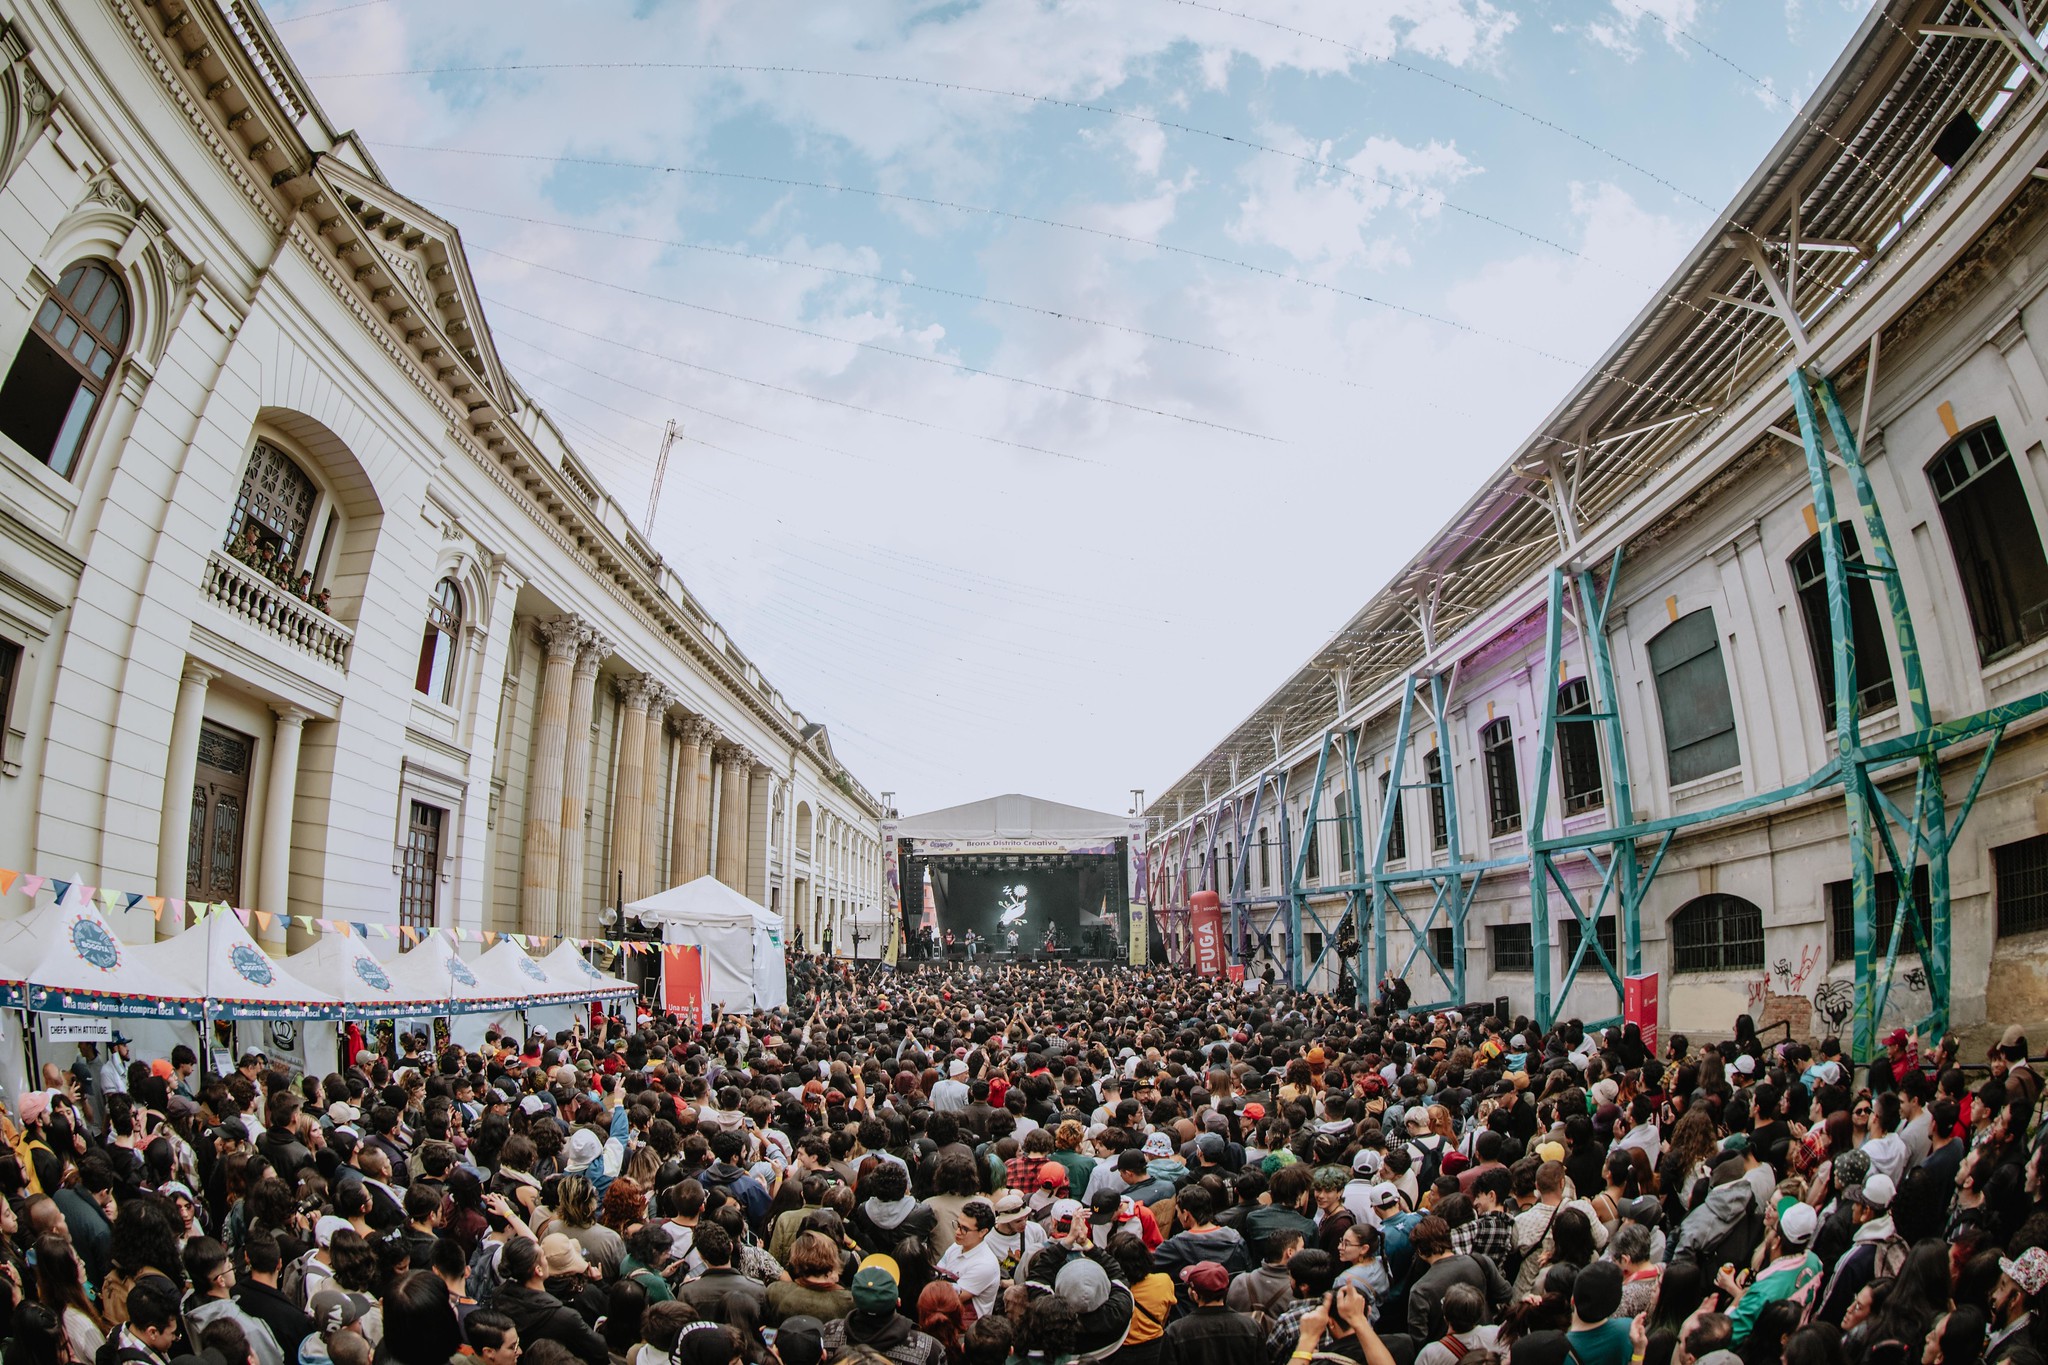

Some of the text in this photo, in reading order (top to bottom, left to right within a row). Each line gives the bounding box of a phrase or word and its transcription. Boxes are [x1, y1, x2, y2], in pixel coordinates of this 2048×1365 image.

[1198, 921, 1217, 973] FUGA
[78, 1002, 99, 1011] nuev
[99, 1001, 119, 1012] forma
[120, 1003, 129, 1013] de
[129, 1006, 157, 1016] comprar
[50, 1026, 67, 1035] CHEFS
[69, 1026, 82, 1034] WITH
